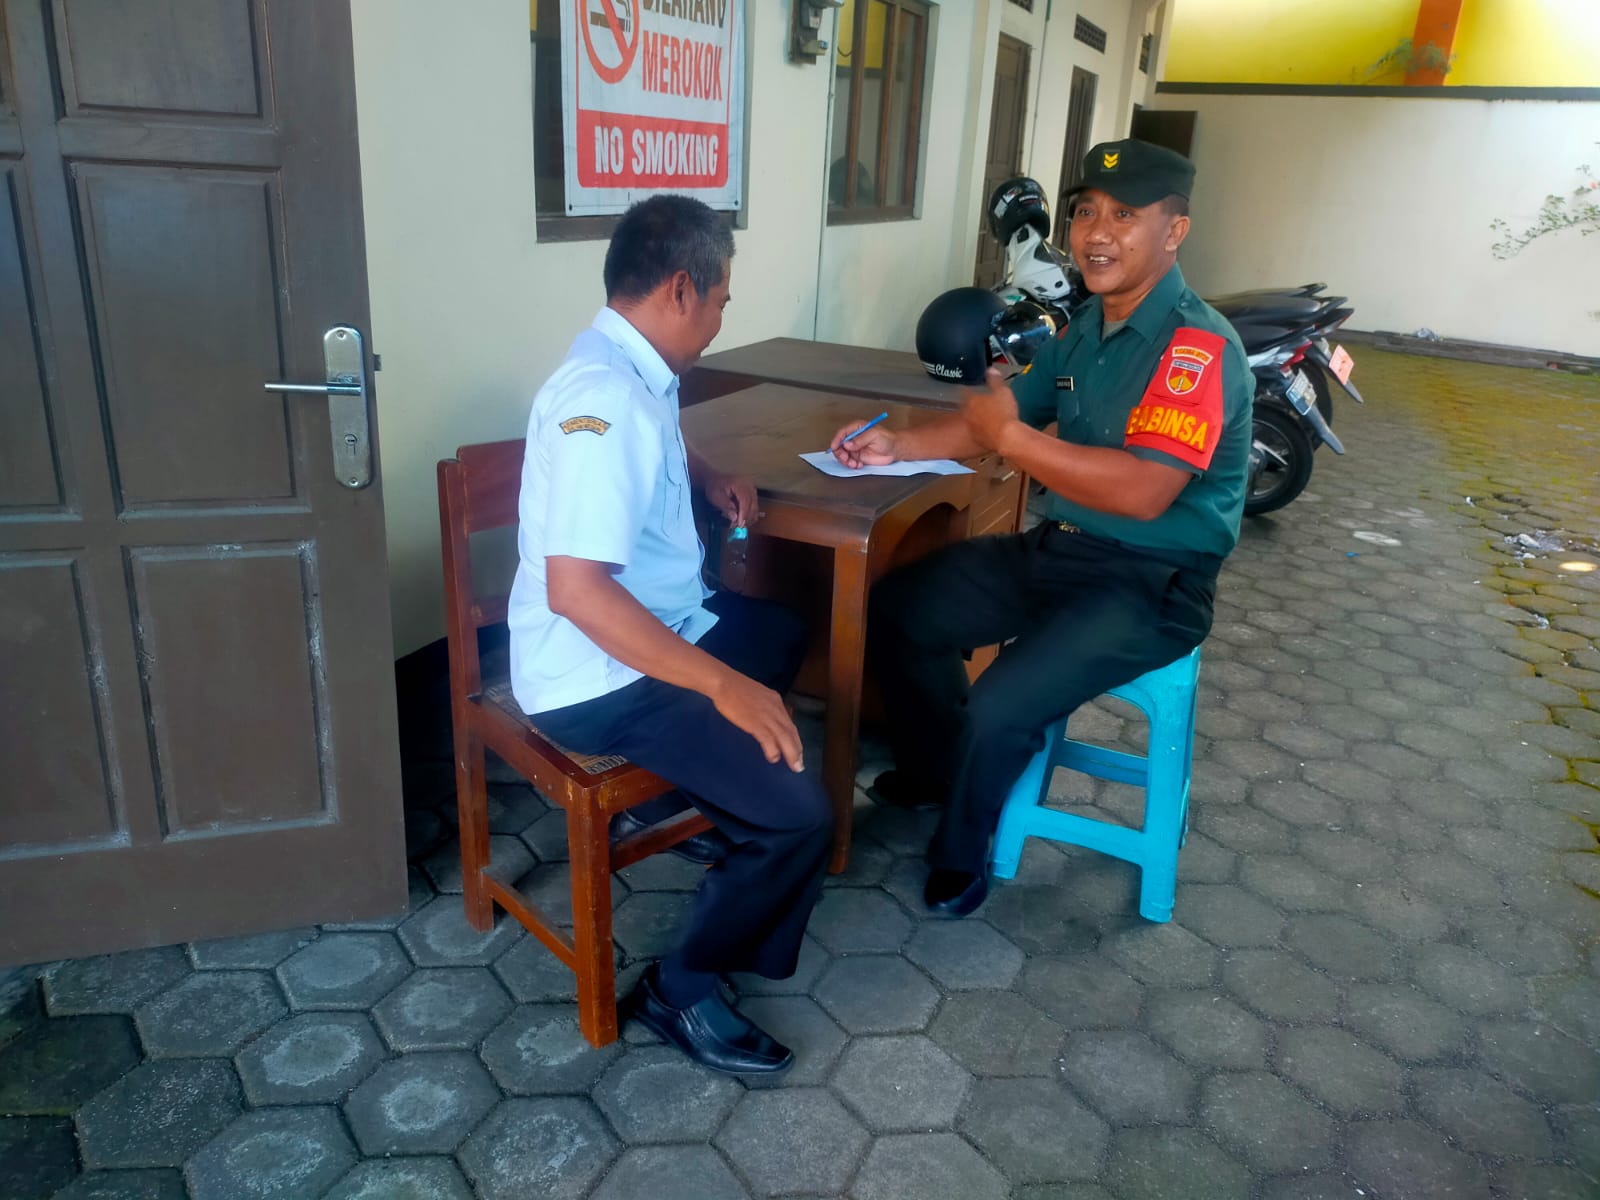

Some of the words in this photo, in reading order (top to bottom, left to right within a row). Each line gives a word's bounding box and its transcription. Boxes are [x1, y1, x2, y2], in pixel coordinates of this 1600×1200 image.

[643, 31, 722, 101] MEROKOK
[595, 126, 624, 175] NO
[632, 128, 719, 176] SMOKING
